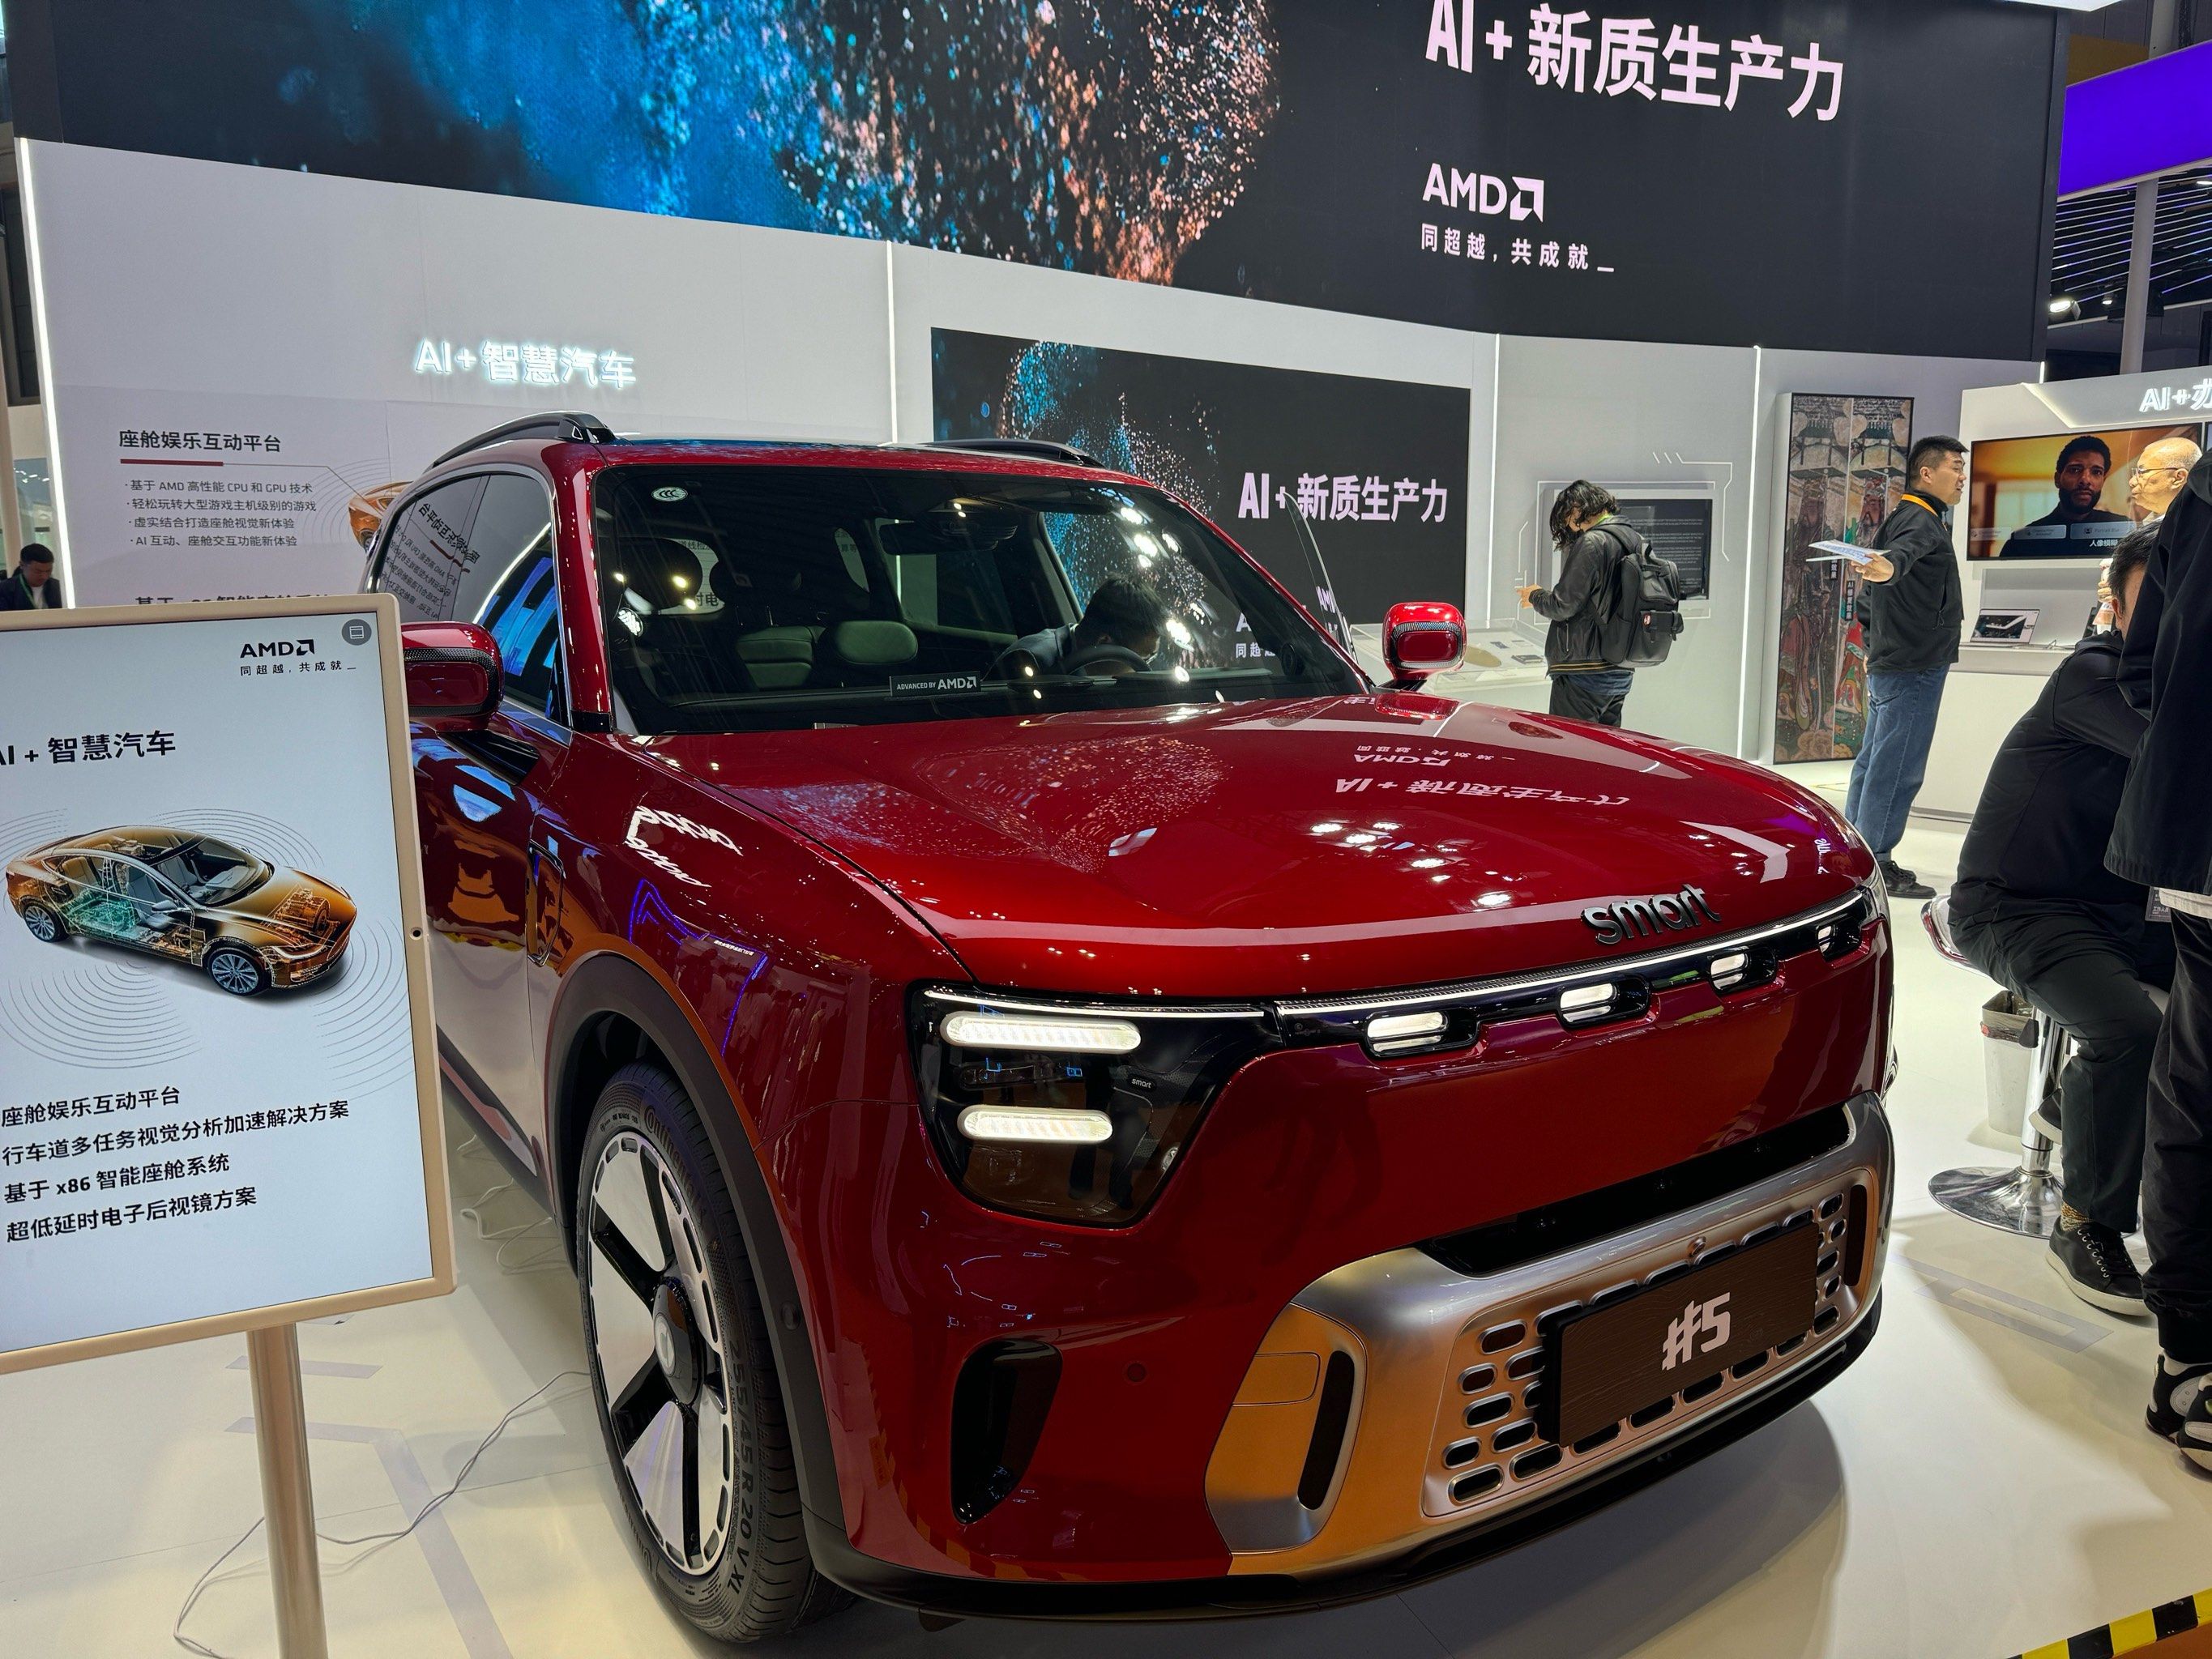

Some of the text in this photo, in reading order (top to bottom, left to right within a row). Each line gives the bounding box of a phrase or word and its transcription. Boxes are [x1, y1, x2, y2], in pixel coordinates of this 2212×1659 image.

[1423, 162, 1508, 215] AMD
[119, 430, 281, 452] 座舱娱乐互动平台
[130, 480, 313, 494] 基于 AMD 高性能 CPU 和 GPU 技术
[131, 498, 317, 512] 轻松玩转大型游戏主机级别的游戏
[134, 517, 295, 529] 虚实结合打造座舱视觉新体验
[135, 535, 147, 545] AI
[240, 641, 294, 658] AMD
[896, 682, 928, 690] ADVANCED
[937, 677, 967, 689] AMD
[47, 730, 176, 764] 智慧汽车
[1581, 883, 1722, 945] smart
[1131, 1078, 1152, 1090] smart
[1, 1085, 181, 1128] 座舱娱乐互动平台
[2, 1100, 349, 1166] 行车道多任务视觉分析加速解决方案
[4, 1154, 230, 1205] 基于 x86 智能座舱系统
[6, 1187, 257, 1243] 超低延时电子后视镜方案
[1662, 1291, 1731, 1371] #5
